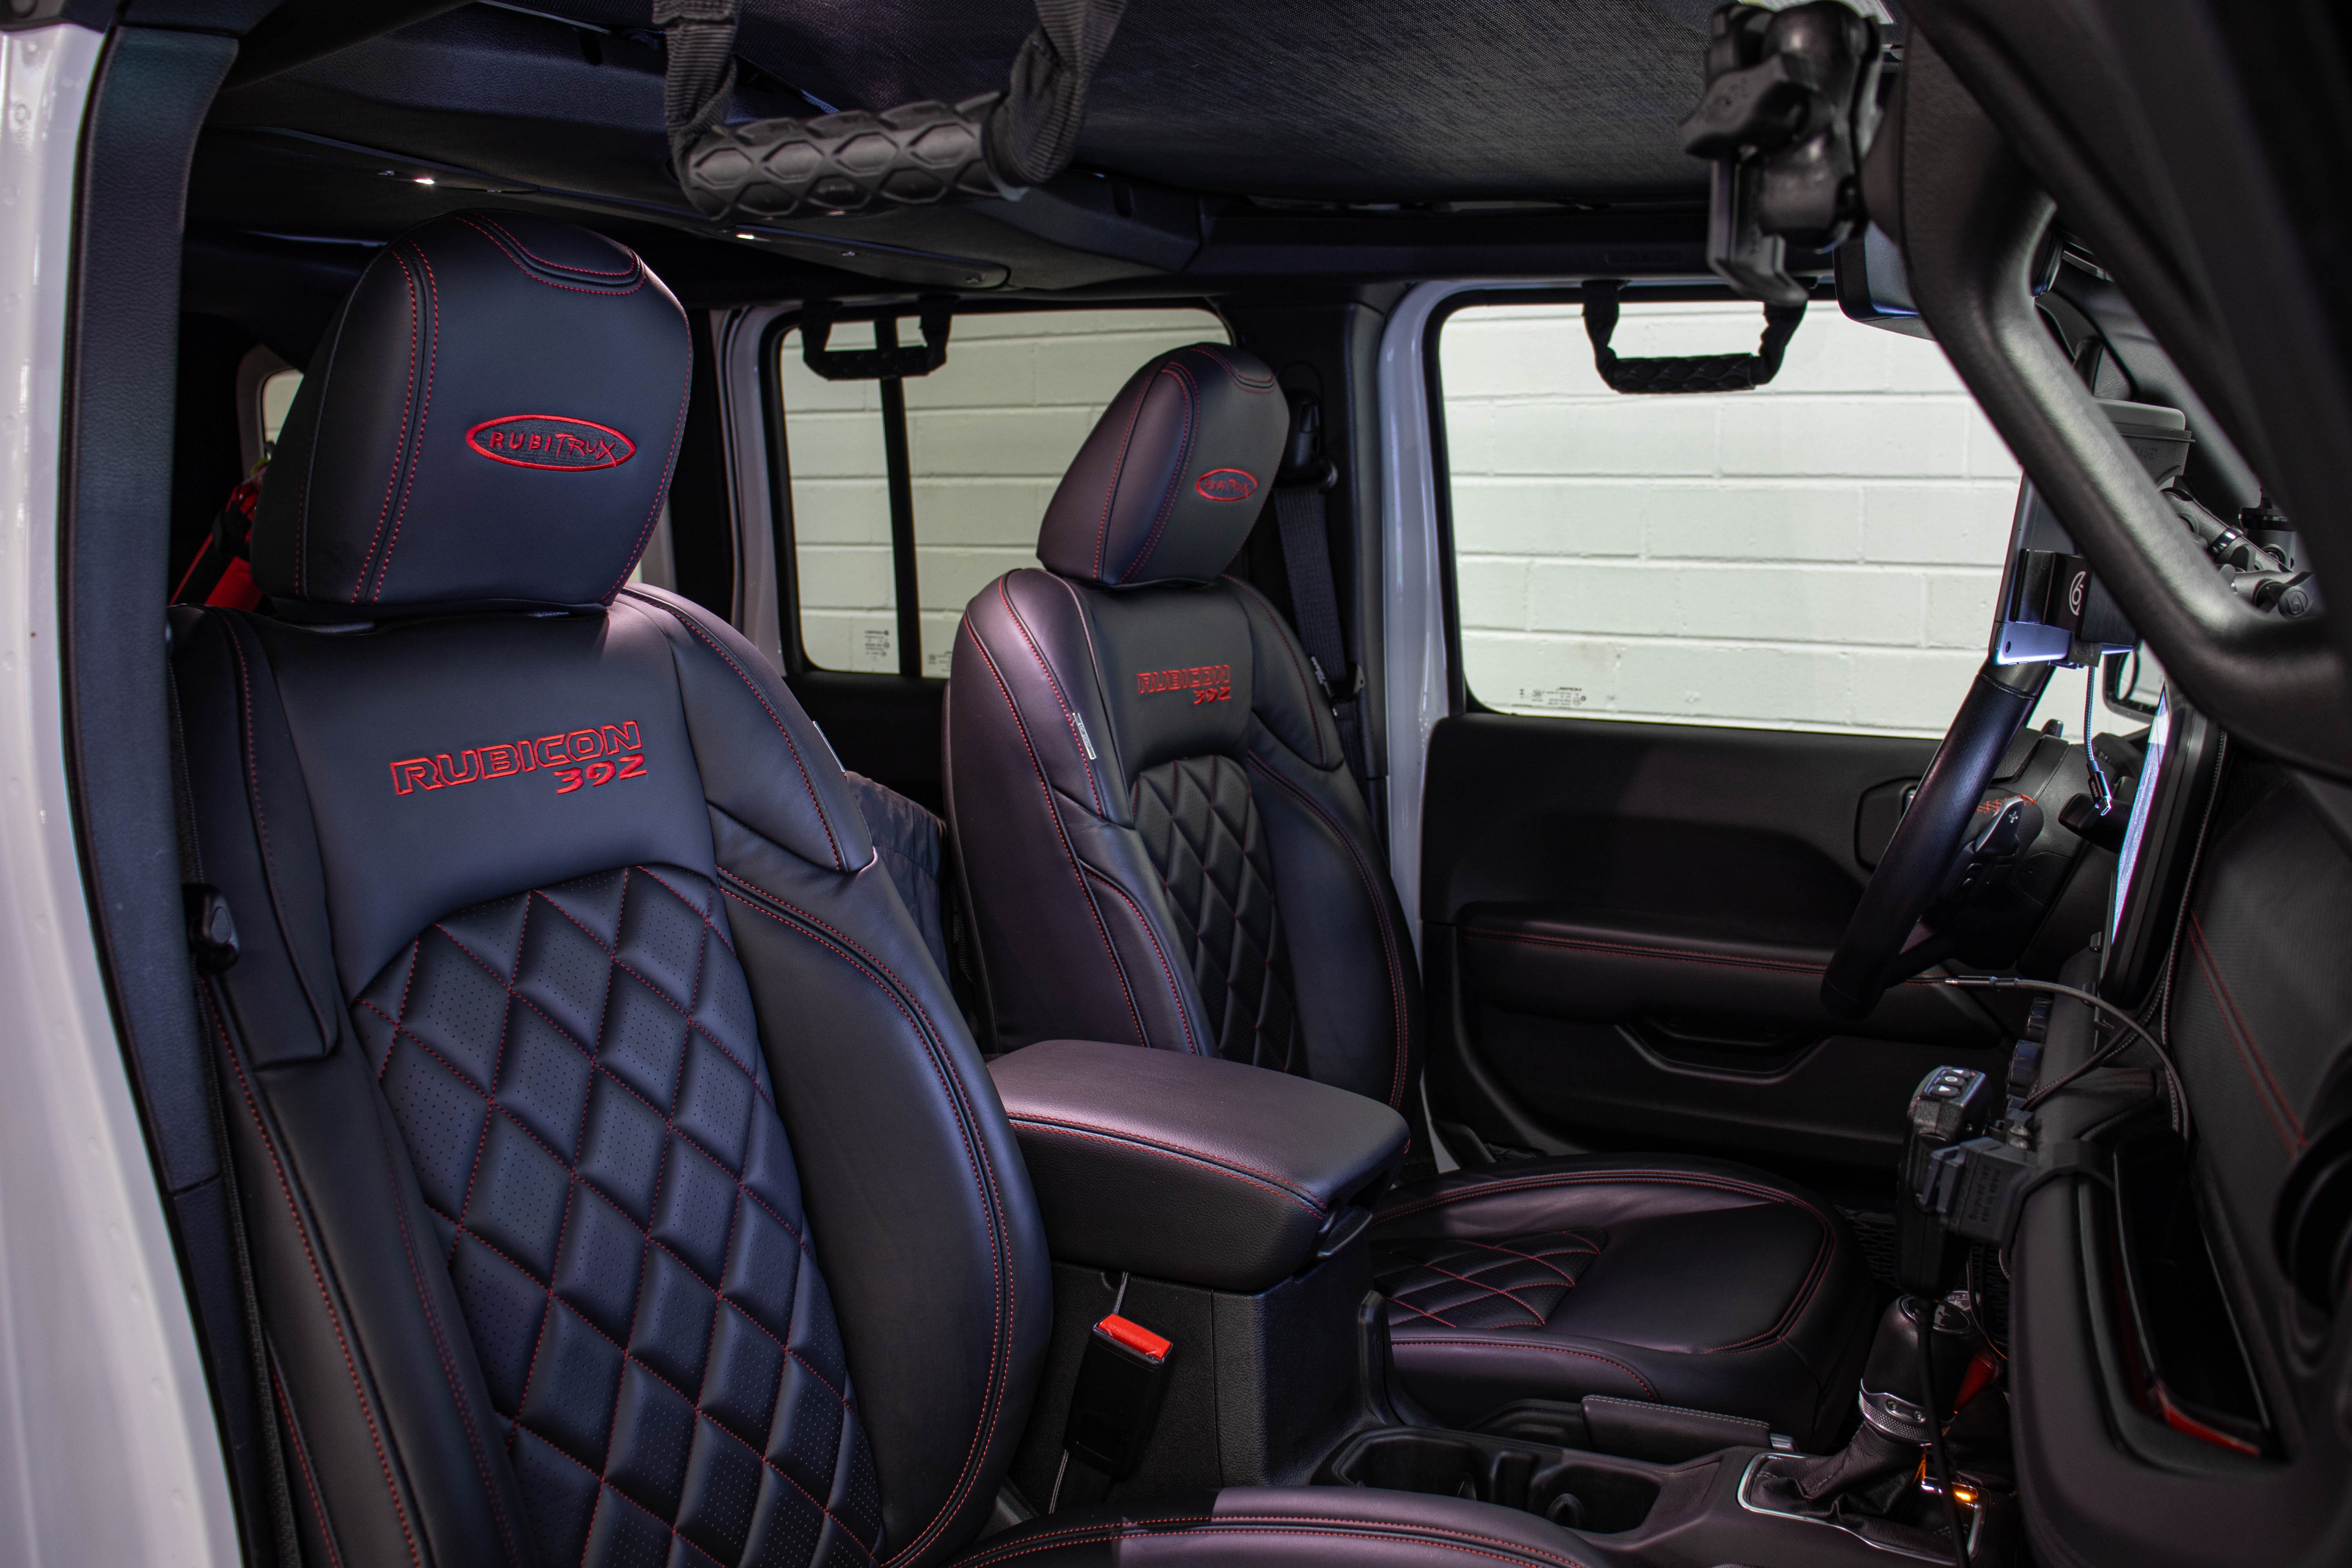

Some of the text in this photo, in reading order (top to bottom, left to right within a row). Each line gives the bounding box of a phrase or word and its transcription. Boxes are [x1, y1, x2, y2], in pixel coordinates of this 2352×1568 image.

[490, 432, 616, 468] RUBITRUX
[1137, 664, 1230, 694] RUBICON
[1193, 686, 1231, 705] 392
[390, 720, 643, 795] RUBICON
[553, 753, 647, 794] 392
